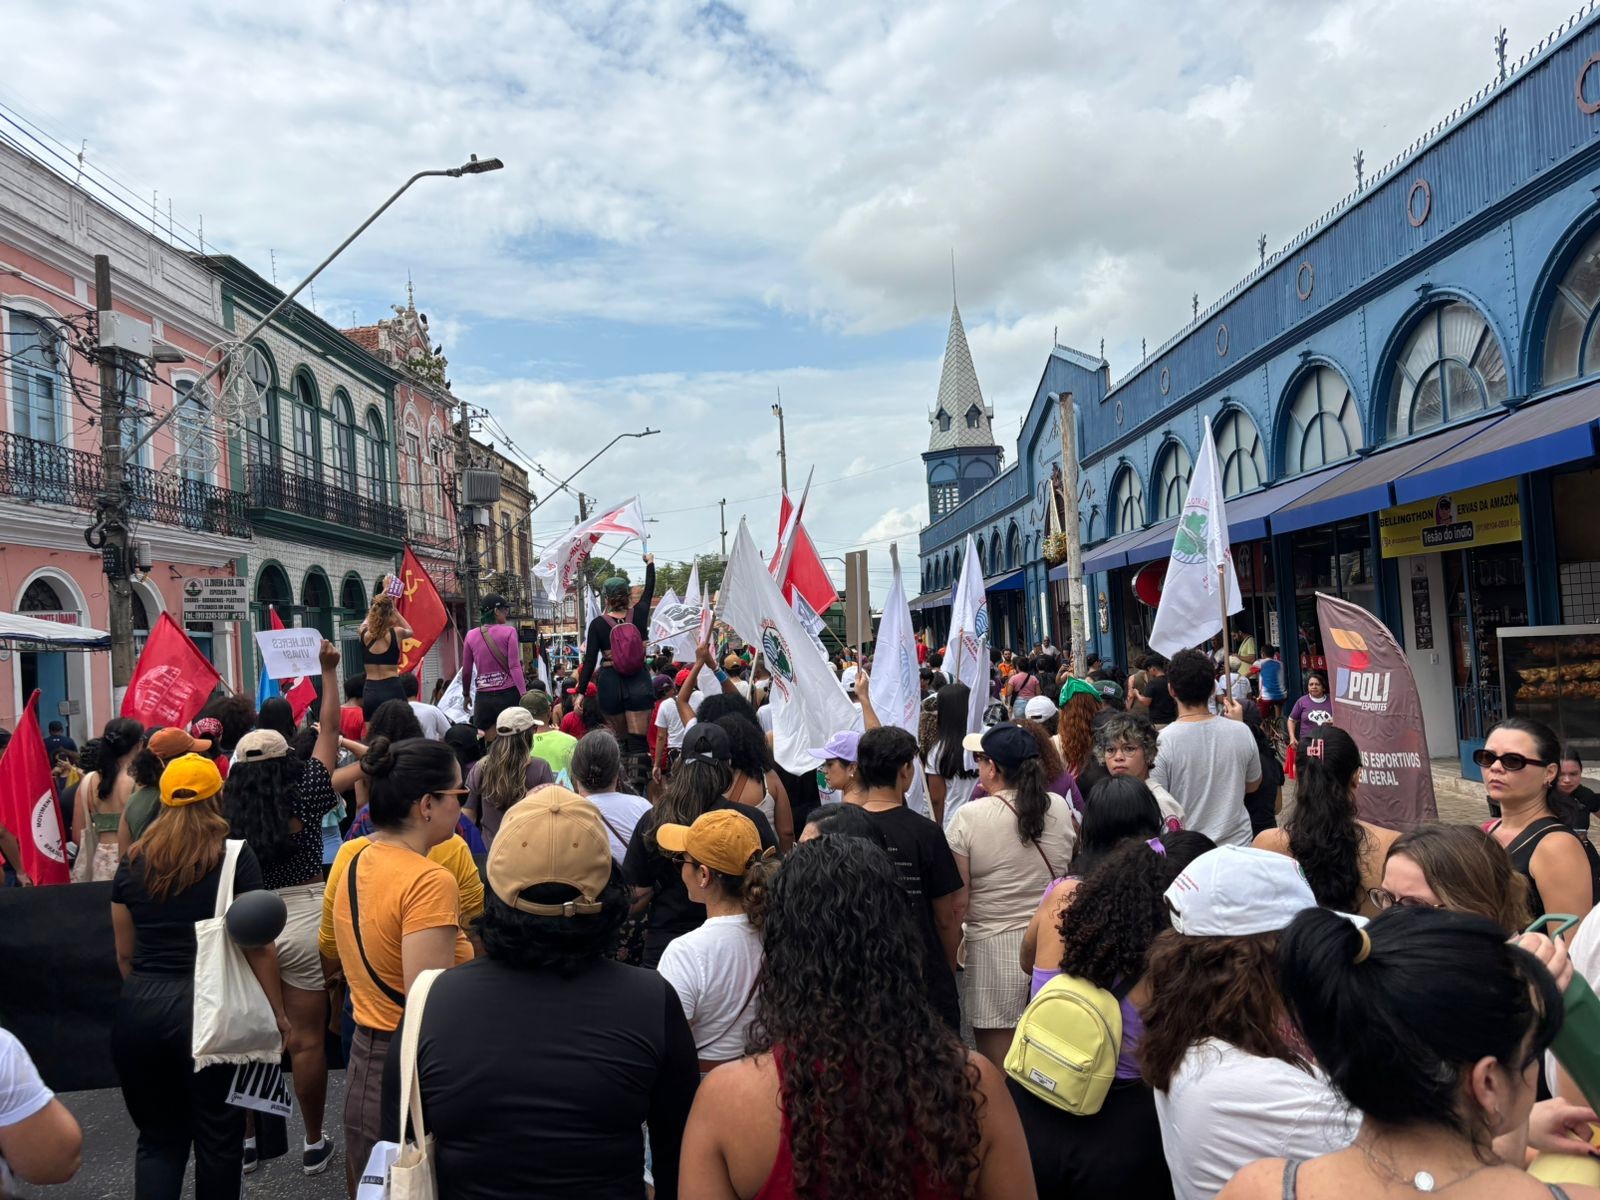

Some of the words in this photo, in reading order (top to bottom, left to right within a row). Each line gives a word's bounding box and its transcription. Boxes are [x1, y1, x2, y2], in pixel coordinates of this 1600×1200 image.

[1457, 501, 1478, 515] ERVAS
[1480, 499, 1489, 511] DA
[1380, 509, 1434, 528] BELLINGTHON
[1424, 530, 1443, 544] Tesão
[1443, 527, 1453, 540] do
[1348, 671, 1391, 702] POLI
[1361, 702, 1388, 712] ESPORTES
[1370, 751, 1422, 769] ESPORTIVOS
[1369, 770, 1400, 786] GERAL
